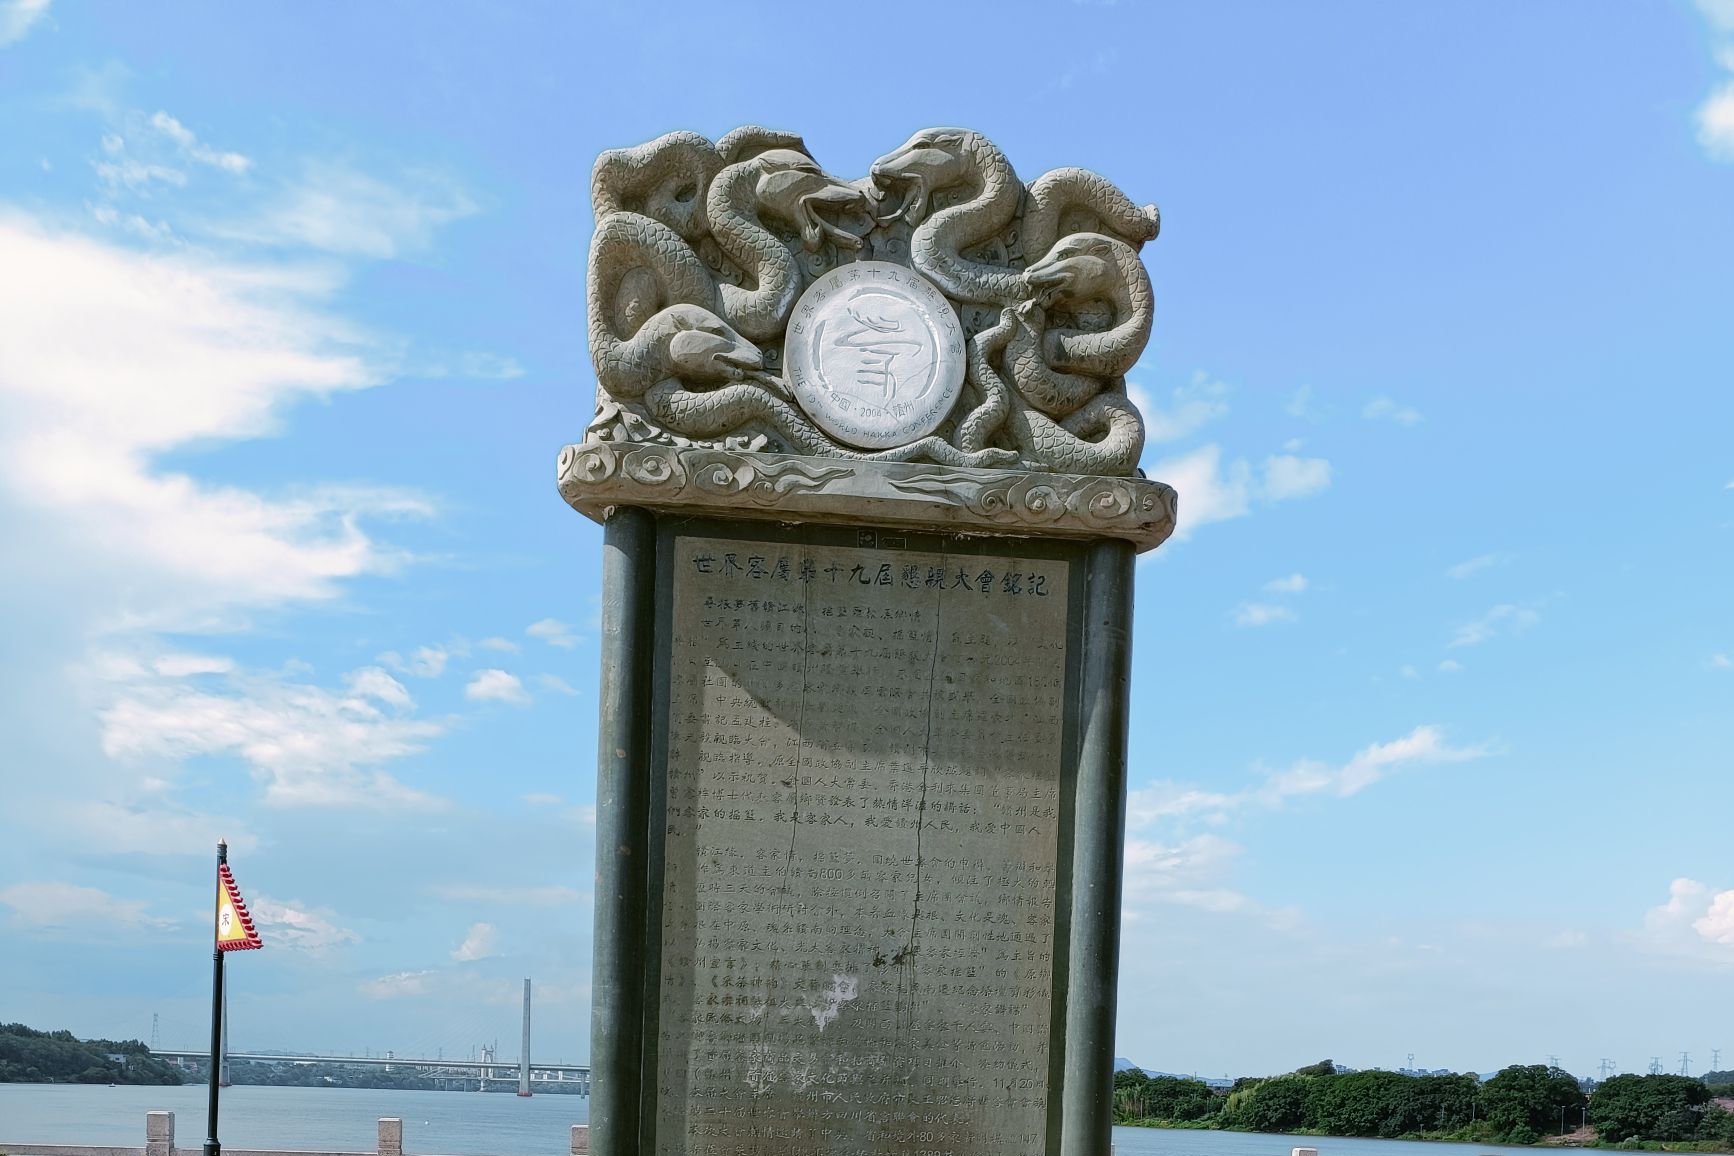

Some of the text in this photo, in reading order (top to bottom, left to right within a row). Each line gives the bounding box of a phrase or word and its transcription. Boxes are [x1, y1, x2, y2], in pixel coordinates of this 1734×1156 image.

[859, 406, 882, 418] 2004
[862, 430, 897, 439] HAKKA
[902, 386, 954, 435] CONFERENCE
